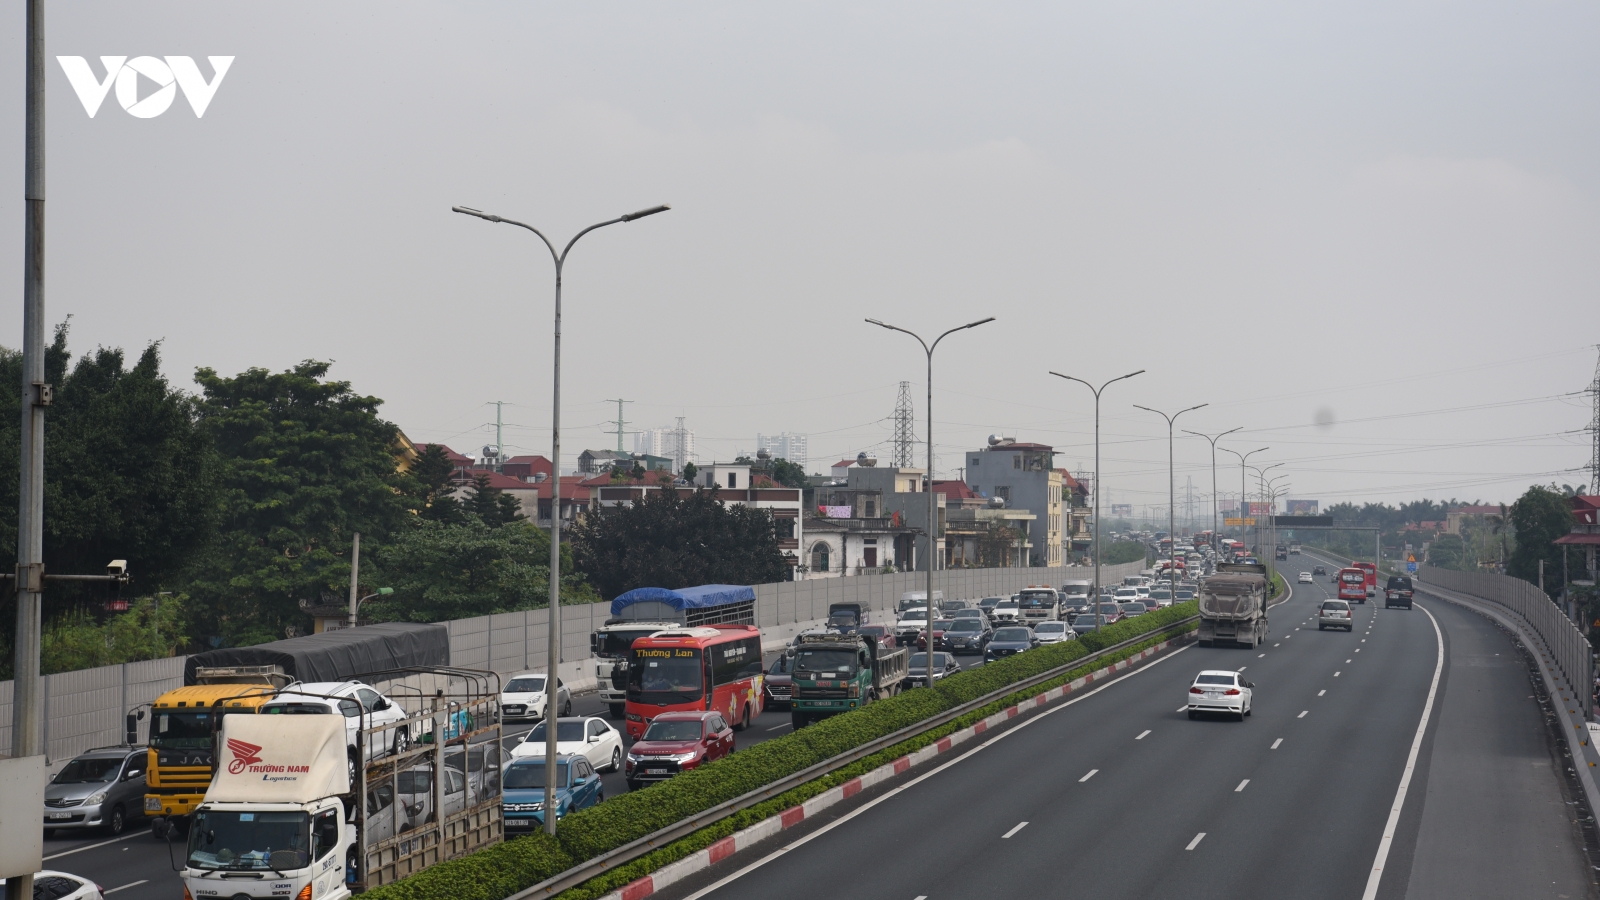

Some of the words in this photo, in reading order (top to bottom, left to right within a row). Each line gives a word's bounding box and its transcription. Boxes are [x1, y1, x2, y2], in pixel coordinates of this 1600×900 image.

[636, 649, 670, 658] Thường
[675, 649, 693, 657] Lan
[248, 763, 285, 773] TRƯỜNG
[287, 765, 310, 773] NAM
[262, 774, 297, 782] Logistics
